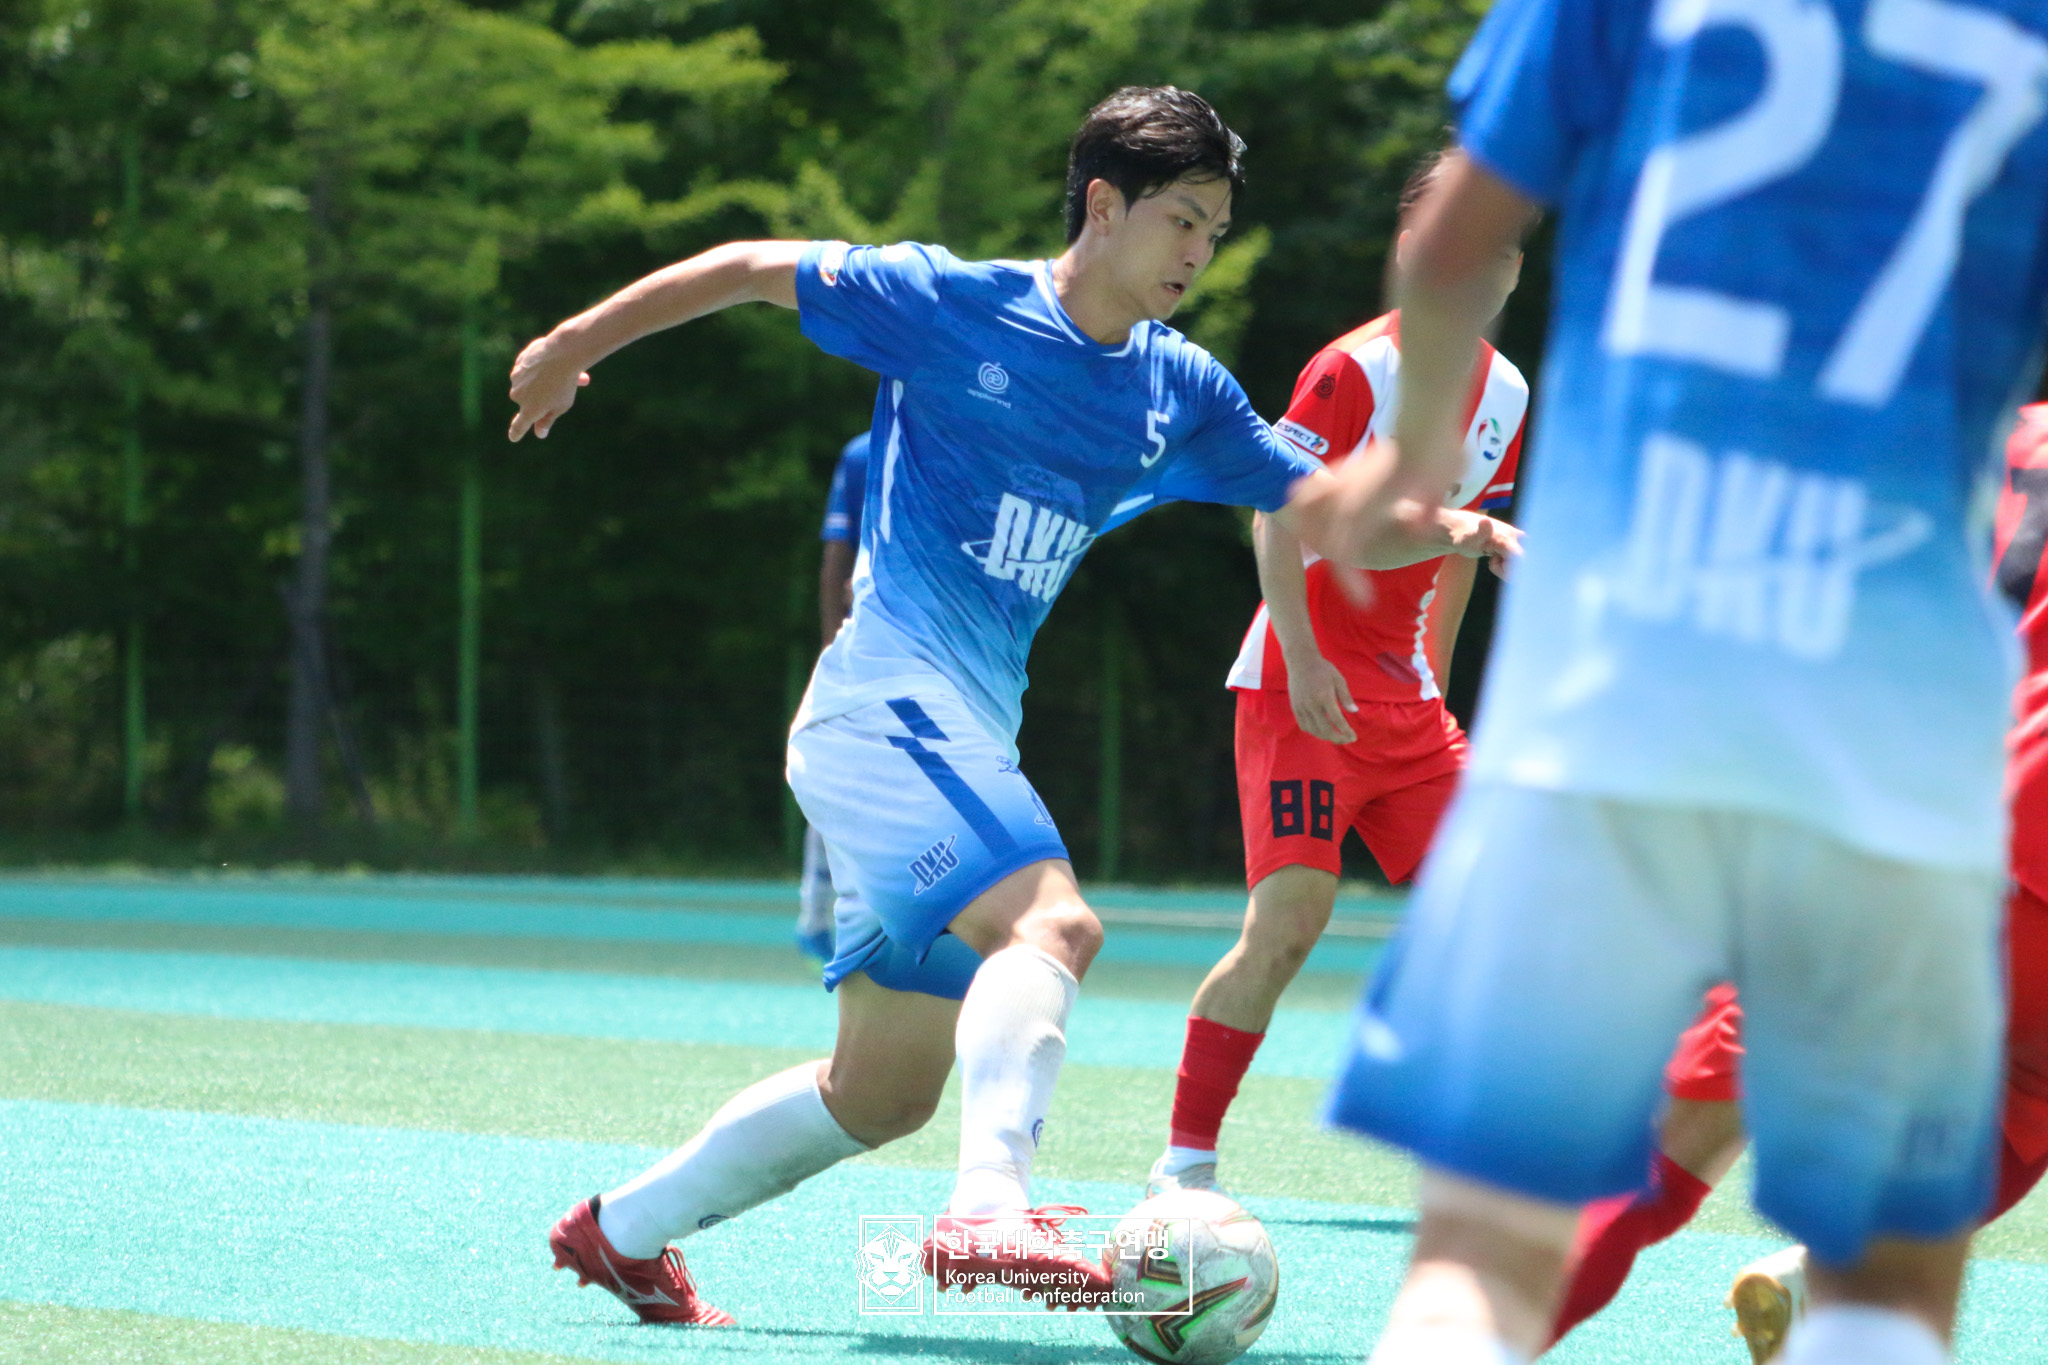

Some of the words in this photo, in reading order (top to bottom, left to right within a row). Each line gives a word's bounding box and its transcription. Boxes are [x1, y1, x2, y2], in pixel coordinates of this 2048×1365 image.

[1607, 0, 2048, 407] 27
[1140, 409, 1170, 468] 5
[1276, 421, 1311, 442] ESPECT
[1269, 779, 1335, 842] 88
[908, 839, 959, 891] DKU
